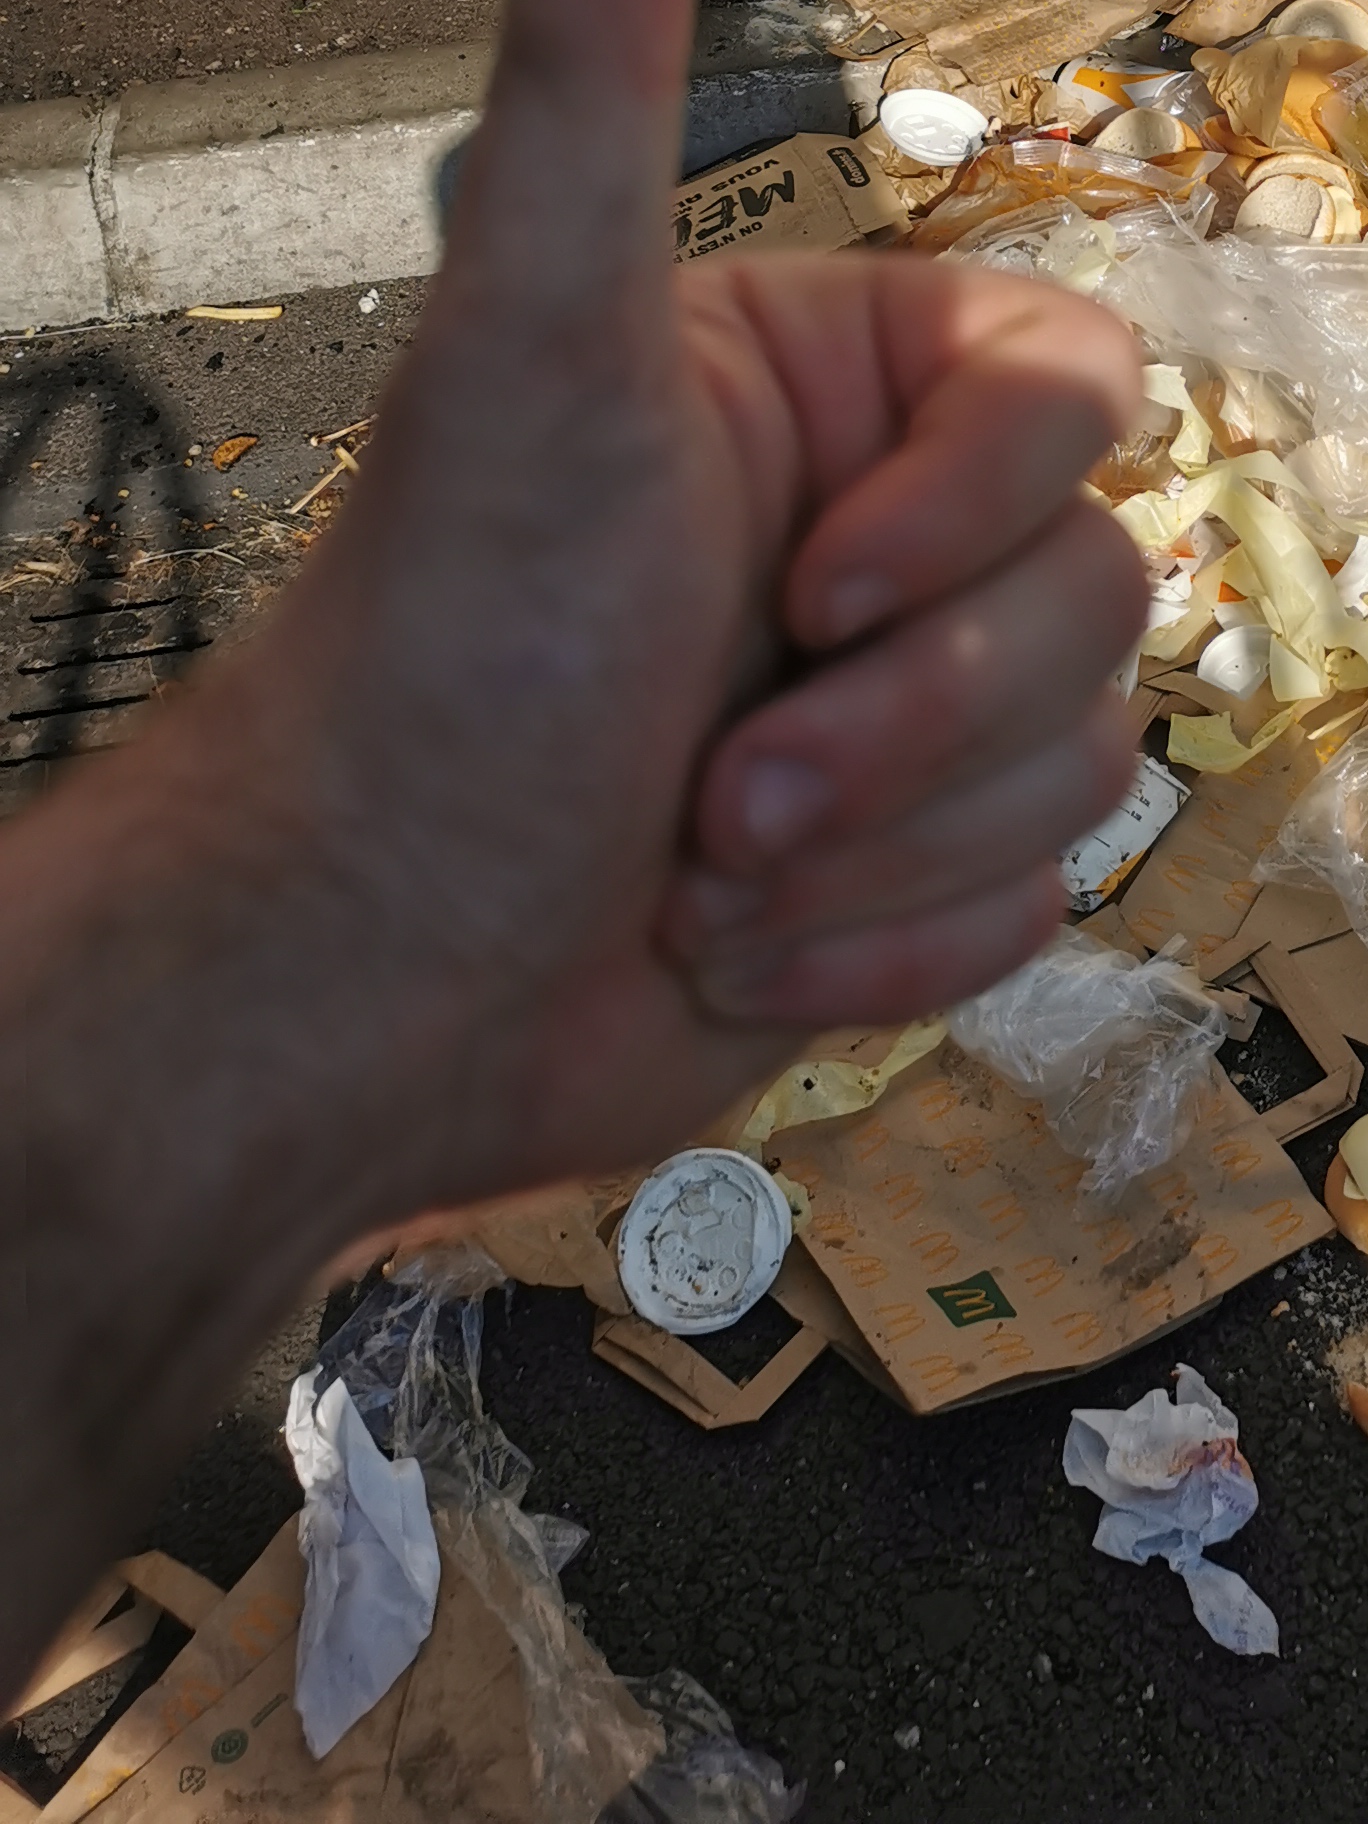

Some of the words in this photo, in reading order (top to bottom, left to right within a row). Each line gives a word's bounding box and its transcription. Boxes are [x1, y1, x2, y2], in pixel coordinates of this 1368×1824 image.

[711, 159, 780, 192] VOUS
[672, 193, 703, 207] AL
[739, 221, 764, 237] ON
[688, 232, 737, 259] N'EST
